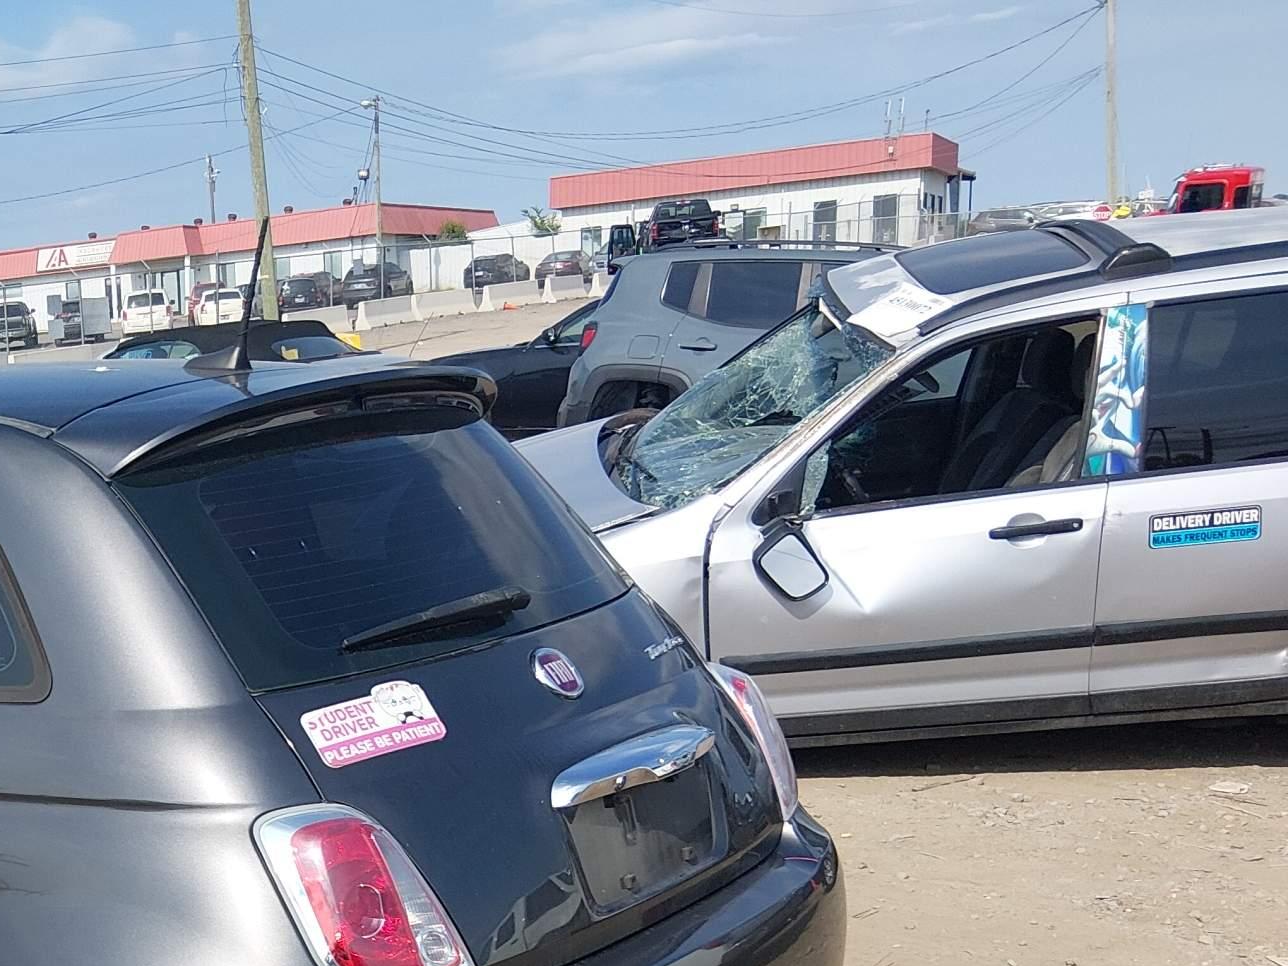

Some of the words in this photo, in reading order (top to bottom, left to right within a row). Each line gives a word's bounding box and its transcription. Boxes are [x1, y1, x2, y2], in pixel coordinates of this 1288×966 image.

[1153, 512, 1212, 531] DELIVERY
[1213, 508, 1259, 525] DRIVER
[1152, 533, 1182, 545] MAKES
[1184, 529, 1228, 542] FREQUENT
[1230, 526, 1258, 538] STOPS
[544, 659, 576, 686] FIAT
[307, 700, 376, 731] STUDENT
[320, 716, 380, 742] DRIVER
[323, 740, 373, 764] PLEASE
[376, 734, 393, 749] BE
[394, 722, 443, 744] PATIENT
